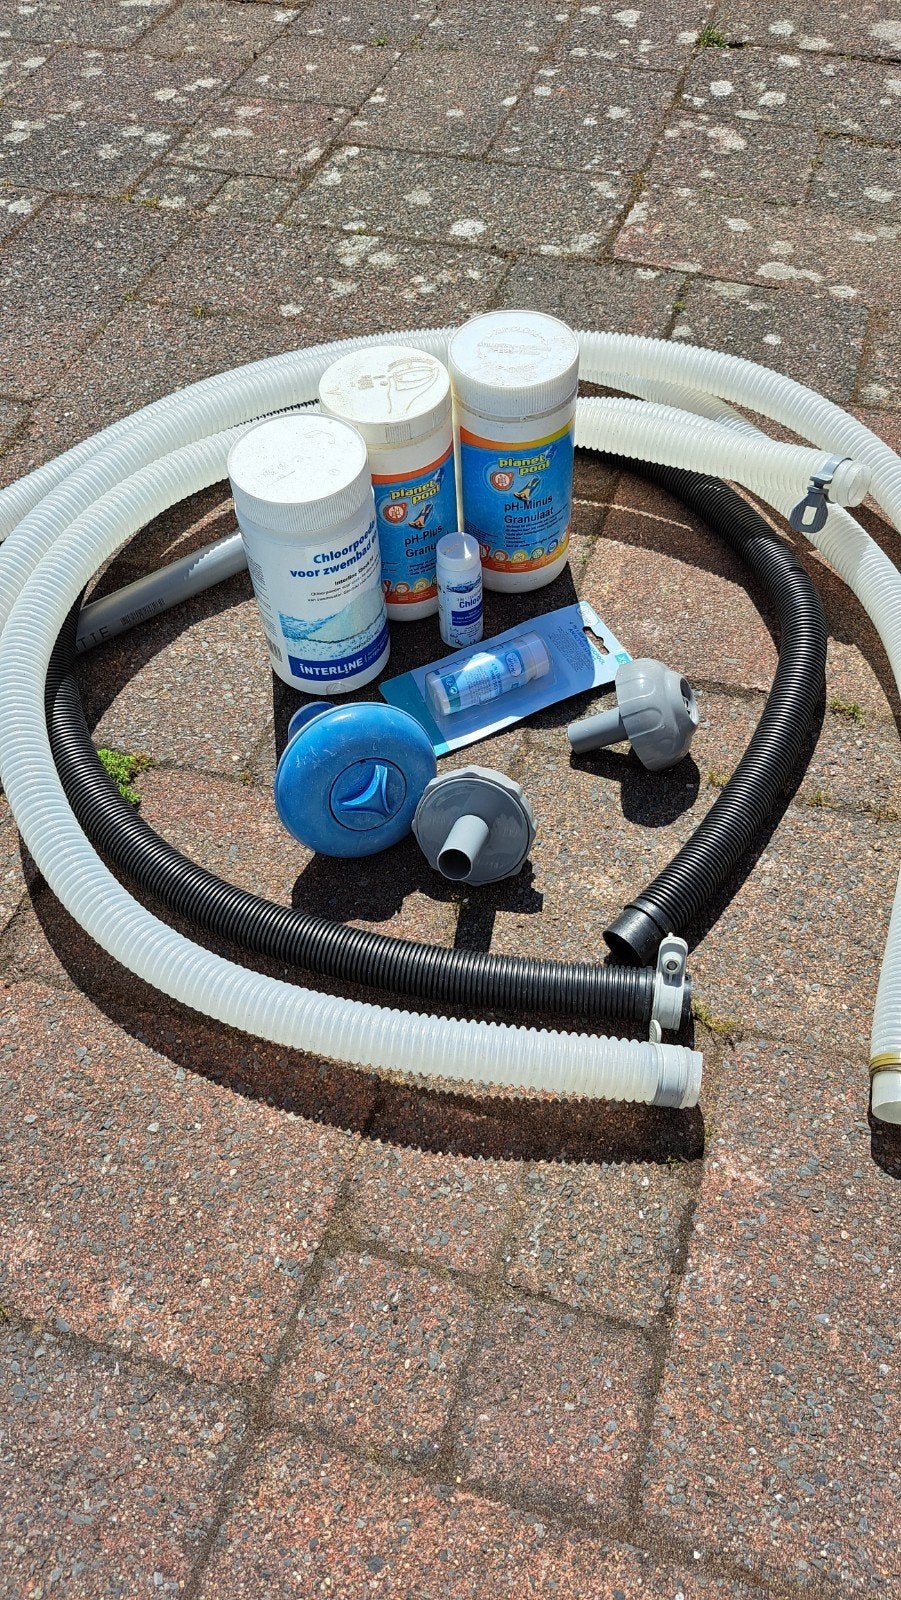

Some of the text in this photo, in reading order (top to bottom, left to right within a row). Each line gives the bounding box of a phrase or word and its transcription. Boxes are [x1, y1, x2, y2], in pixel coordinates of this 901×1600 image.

[497, 454, 545, 468] planet
[518, 460, 550, 475] pool
[390, 480, 435, 500] planet
[412, 485, 440, 505] pool
[504, 495, 553, 512] pH-Minus
[504, 507, 553, 524] Granulaat
[313, 516, 375, 563] Chloorpoede
[404, 525, 443, 547] pH-Plus
[290, 569, 320, 578] voor
[323, 539, 371, 576] zwembad
[405, 543, 437, 558] Granu
[299, 657, 363, 676] INTERLINE
